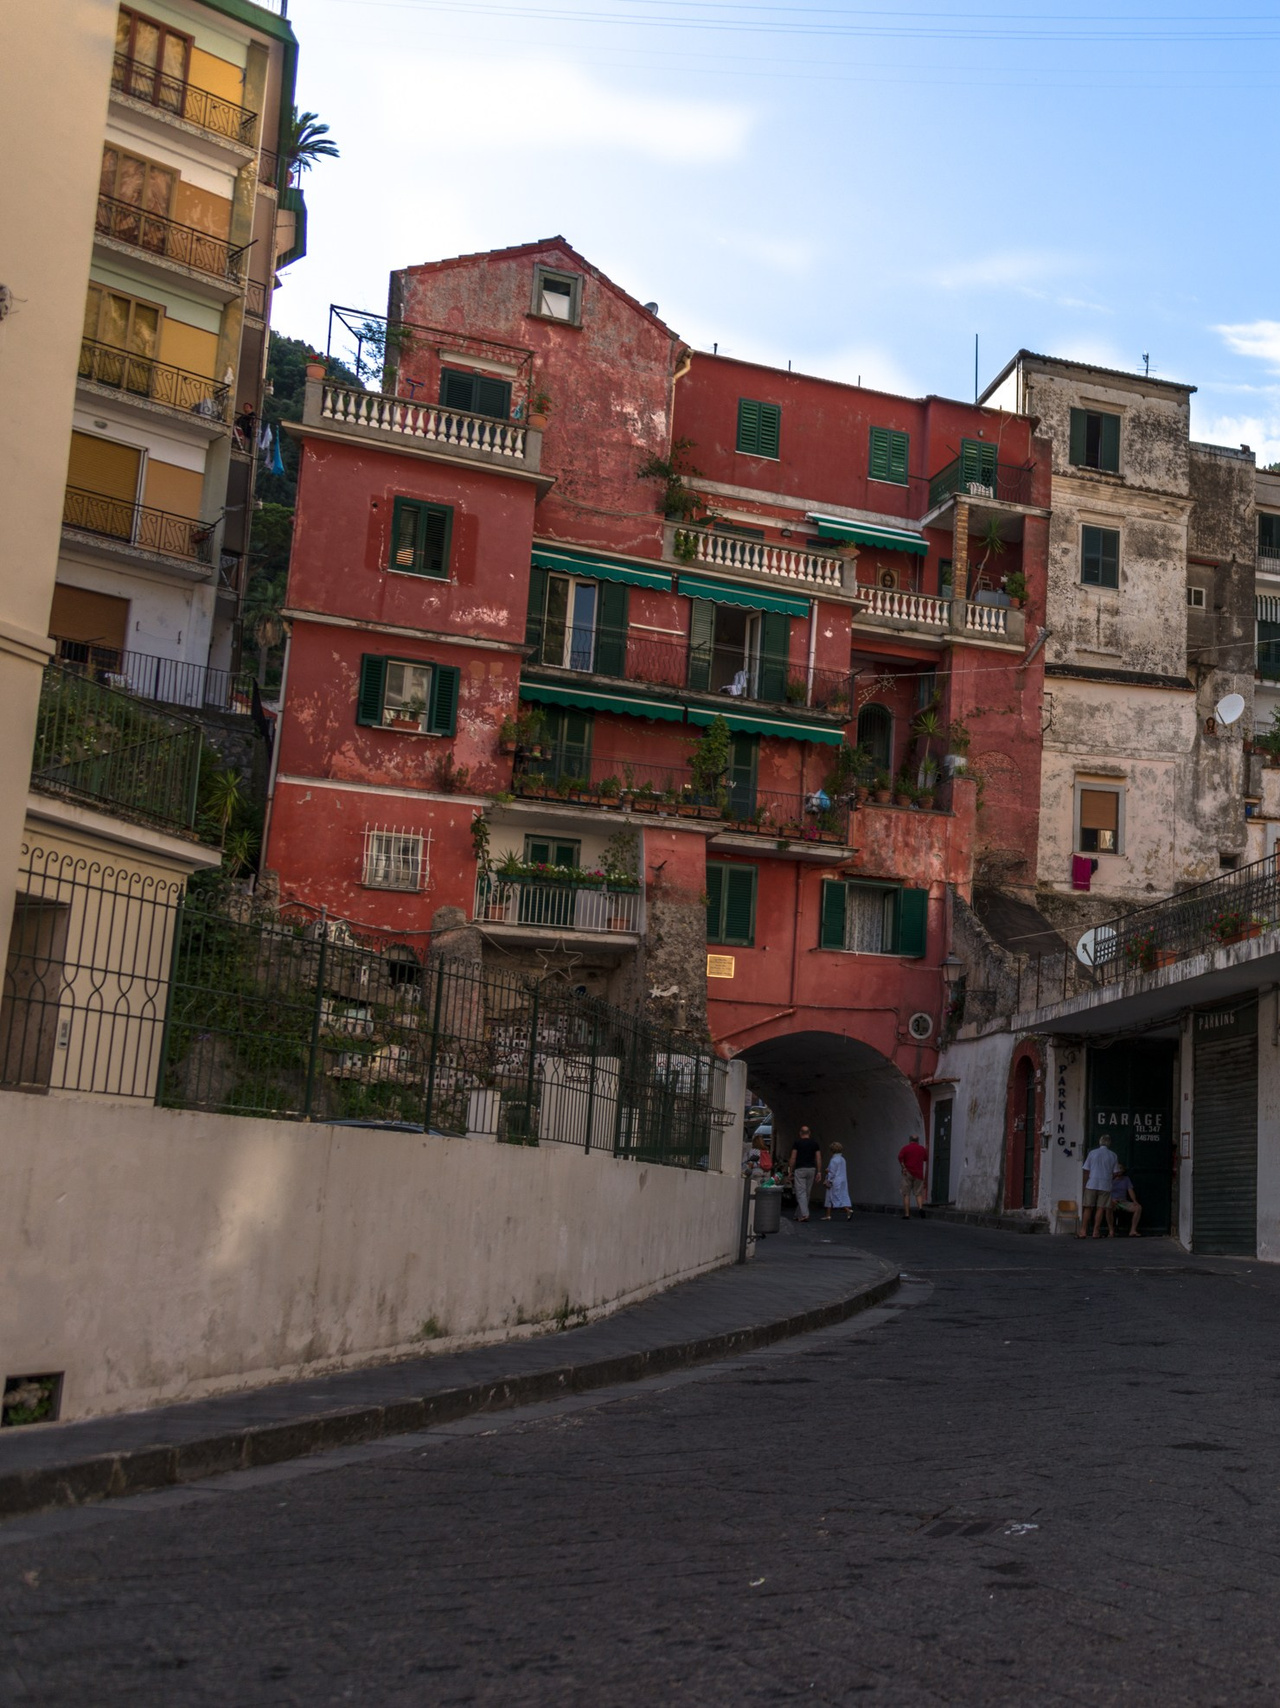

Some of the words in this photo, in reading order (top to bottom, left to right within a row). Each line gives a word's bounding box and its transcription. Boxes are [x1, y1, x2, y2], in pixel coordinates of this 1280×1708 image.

[1198, 1011, 1235, 1030] PARKING
[1057, 1065, 1068, 1146] PARKING
[1097, 1112, 1163, 1126] GARAGE
